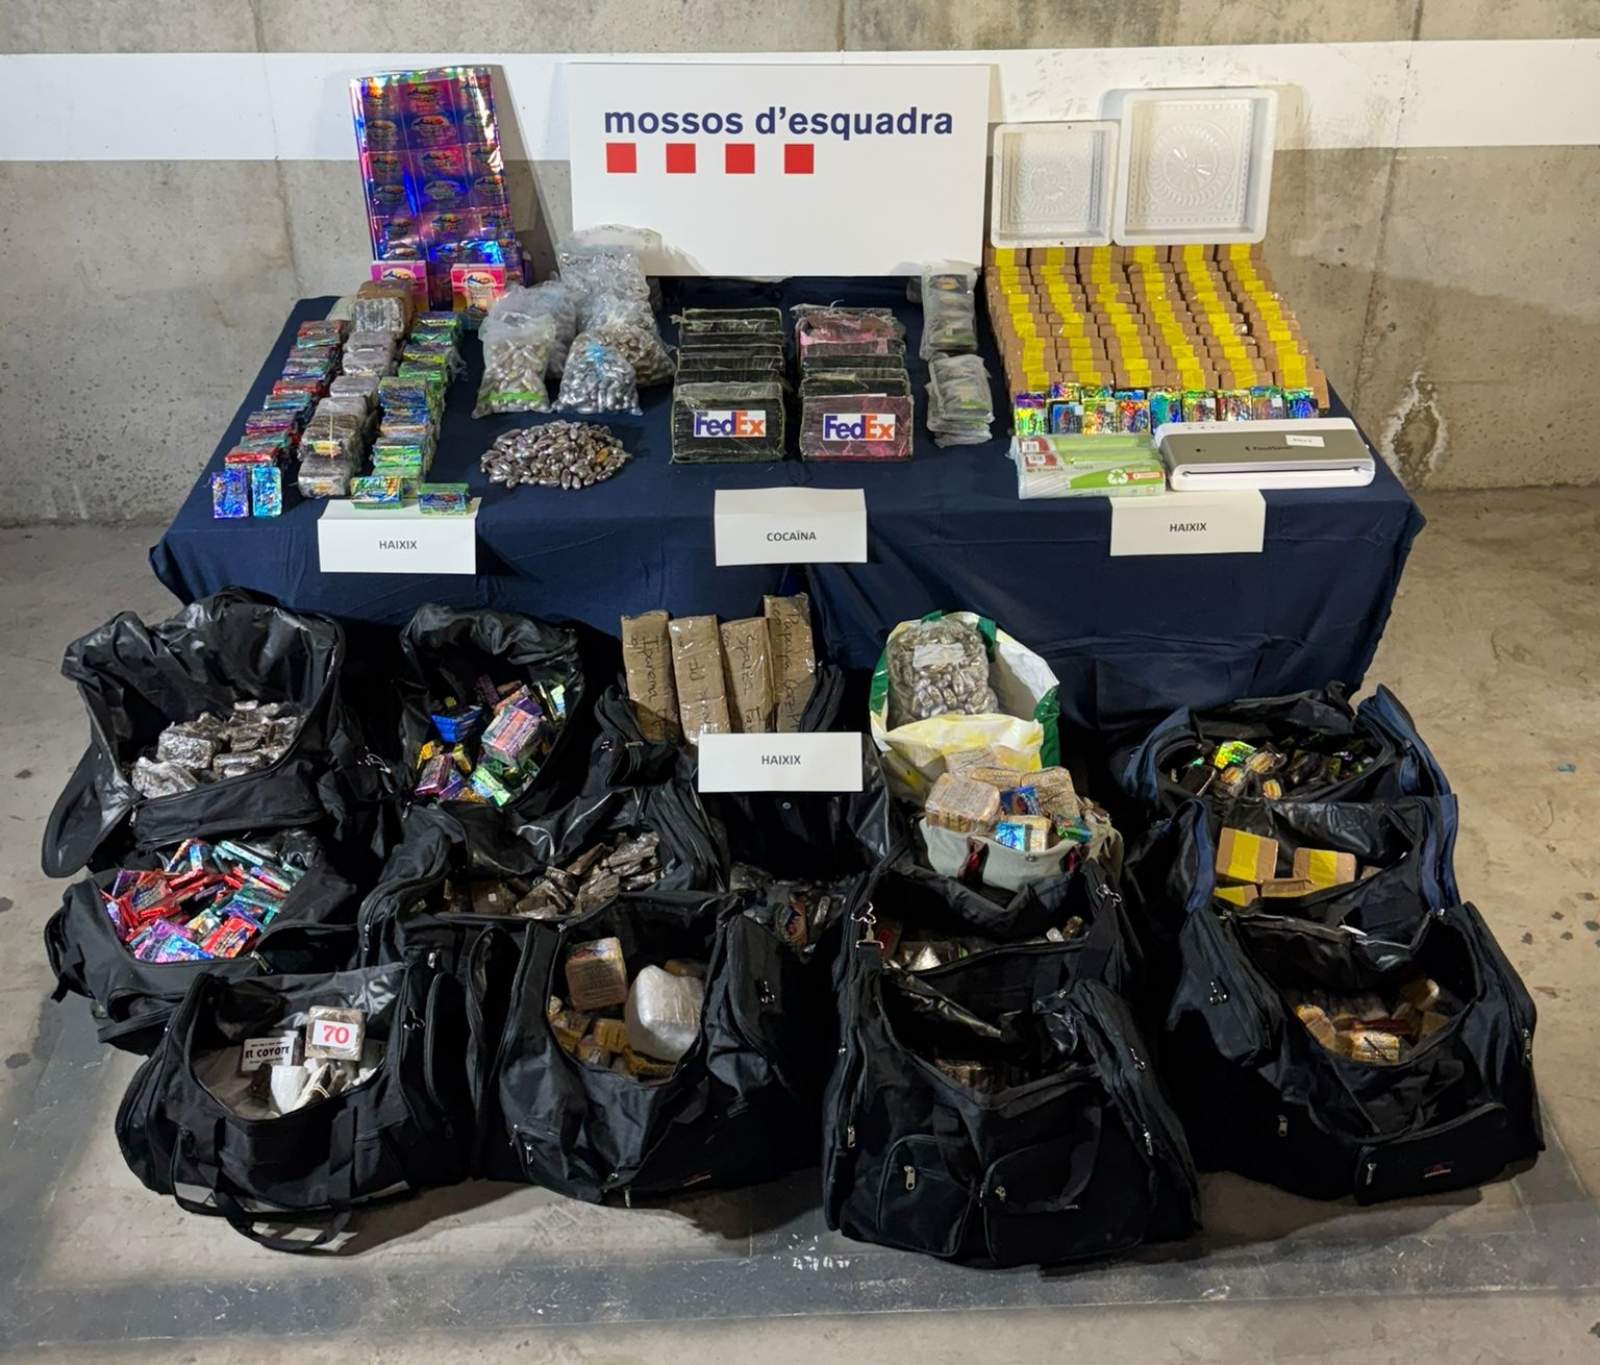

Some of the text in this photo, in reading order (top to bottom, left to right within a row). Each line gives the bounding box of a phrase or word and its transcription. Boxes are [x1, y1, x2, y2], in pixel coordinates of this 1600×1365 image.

[604, 106, 954, 141] mossos d'esquadra
[694, 410, 765, 436] FedEx
[824, 413, 895, 441] FedEx
[1169, 522, 1207, 532] HAIXIX
[766, 529, 817, 541] COCAÏNA
[379, 540, 418, 550] HAIXIX
[761, 755, 801, 765] HAIXIX
[323, 1024, 350, 1044] 70
[256, 1046, 290, 1058] COYOTE
